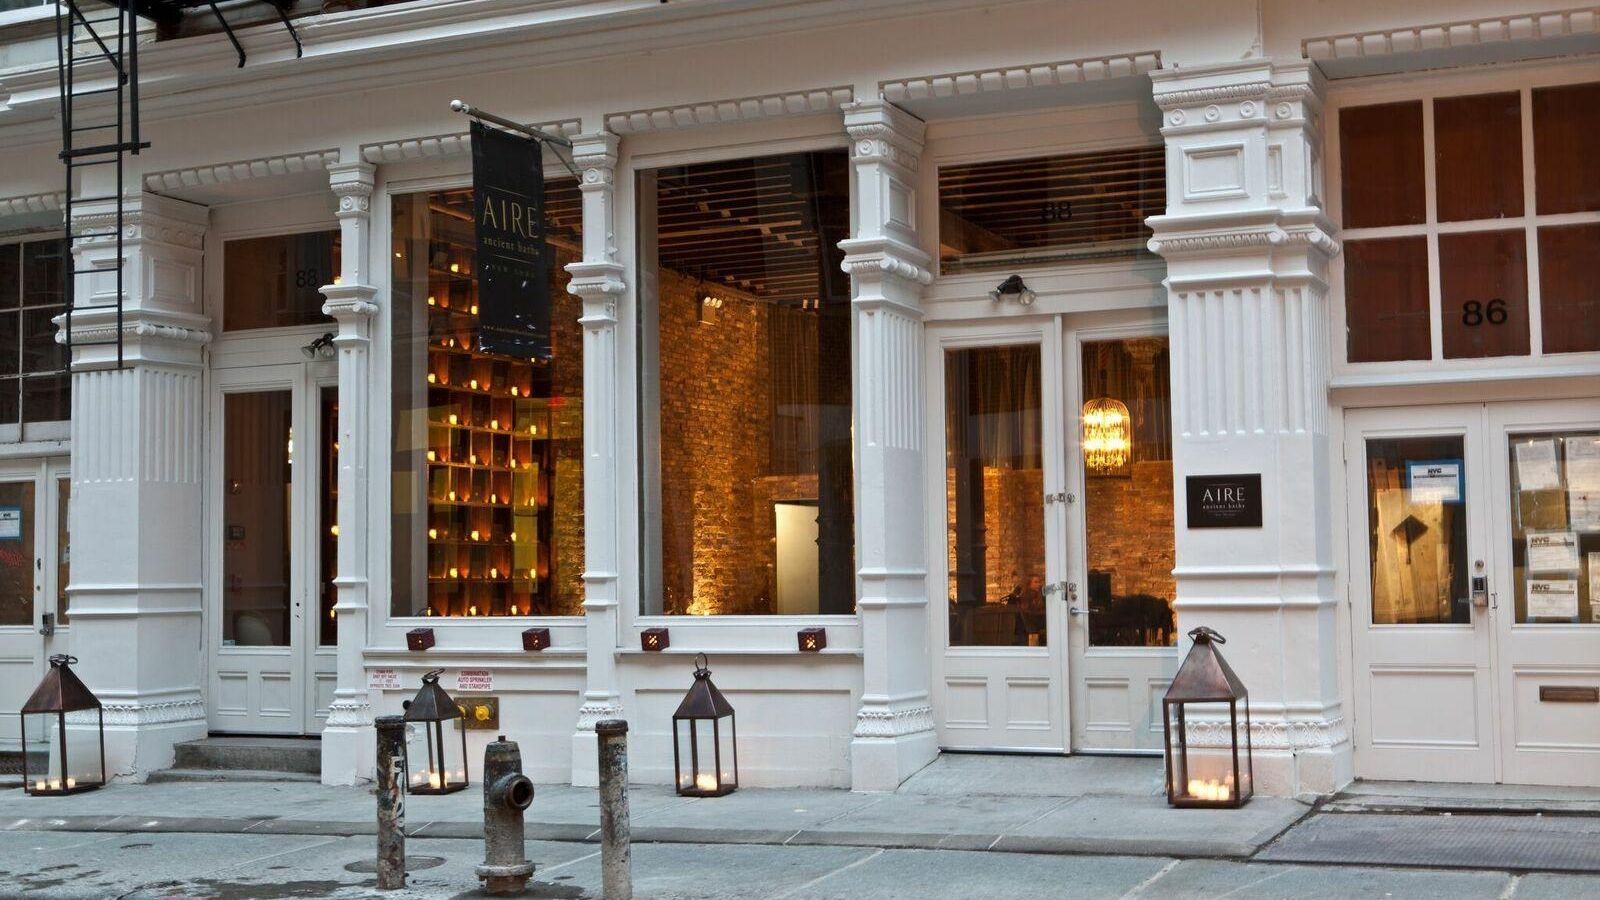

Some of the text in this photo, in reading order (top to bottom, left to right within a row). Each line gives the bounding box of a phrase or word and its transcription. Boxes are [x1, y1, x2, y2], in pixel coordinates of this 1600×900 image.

[482, 195, 539, 239] AIRE
[1041, 200, 1073, 221] 88
[483, 237, 514, 250] ancient
[1462, 298, 1508, 326] 86
[1202, 486, 1246, 502] AIRE
